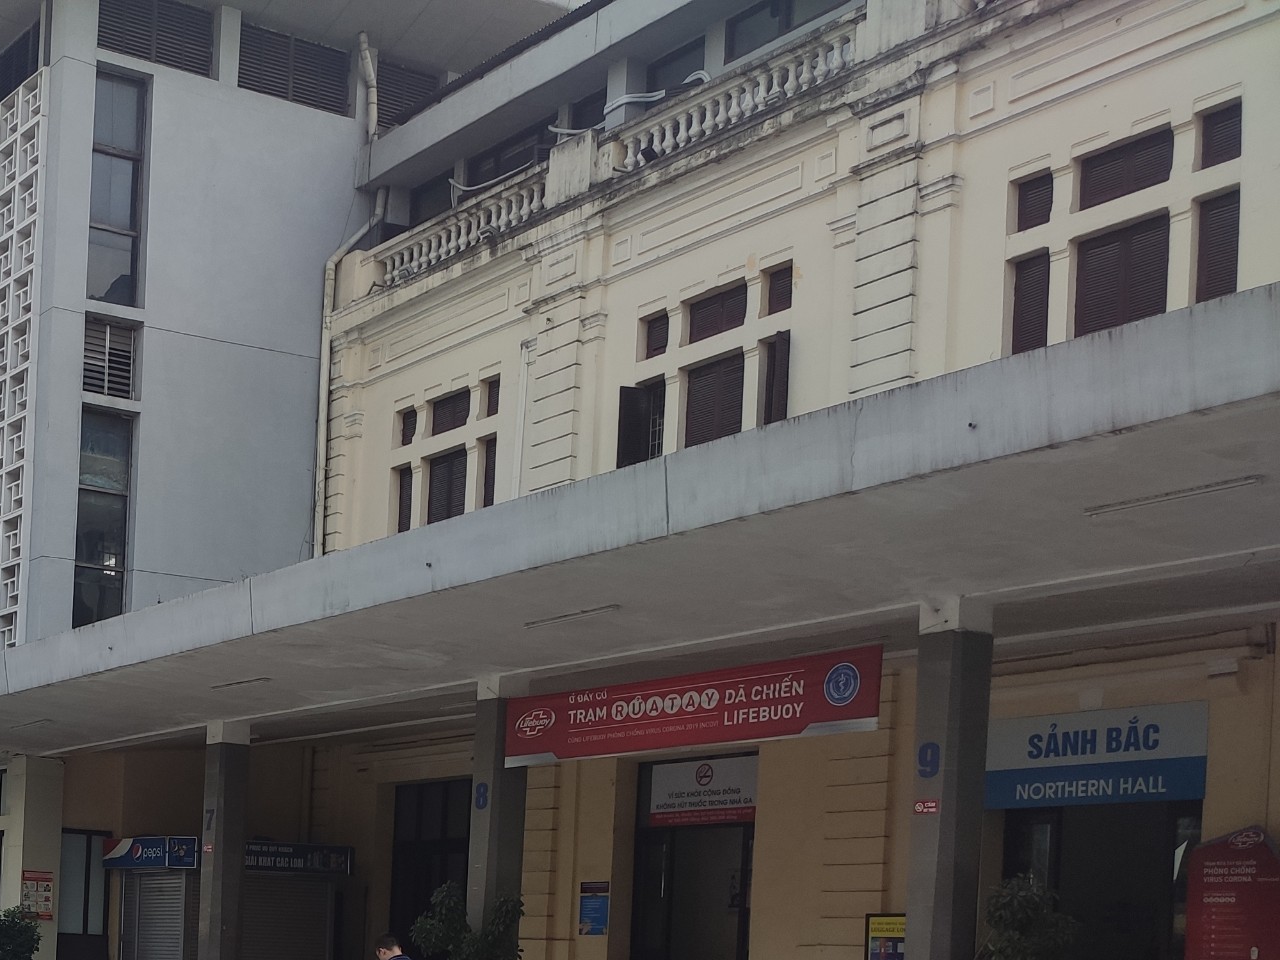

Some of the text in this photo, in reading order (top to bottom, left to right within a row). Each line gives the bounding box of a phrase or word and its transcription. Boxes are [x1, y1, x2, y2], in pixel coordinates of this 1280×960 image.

[567, 705, 607, 726] TRẠM
[724, 684, 747, 705] DÃ
[751, 674, 805, 701] CHIẾN
[723, 702, 805, 726] LIFEBUOY
[1027, 716, 1160, 760] SẢNH BẮC
[917, 742, 940, 778] 9
[476, 783, 488, 809] 8
[1015, 776, 1167, 800] NORTHERN HALL
[206, 809, 215, 830] 7
[142, 845, 163, 860] pepsi
